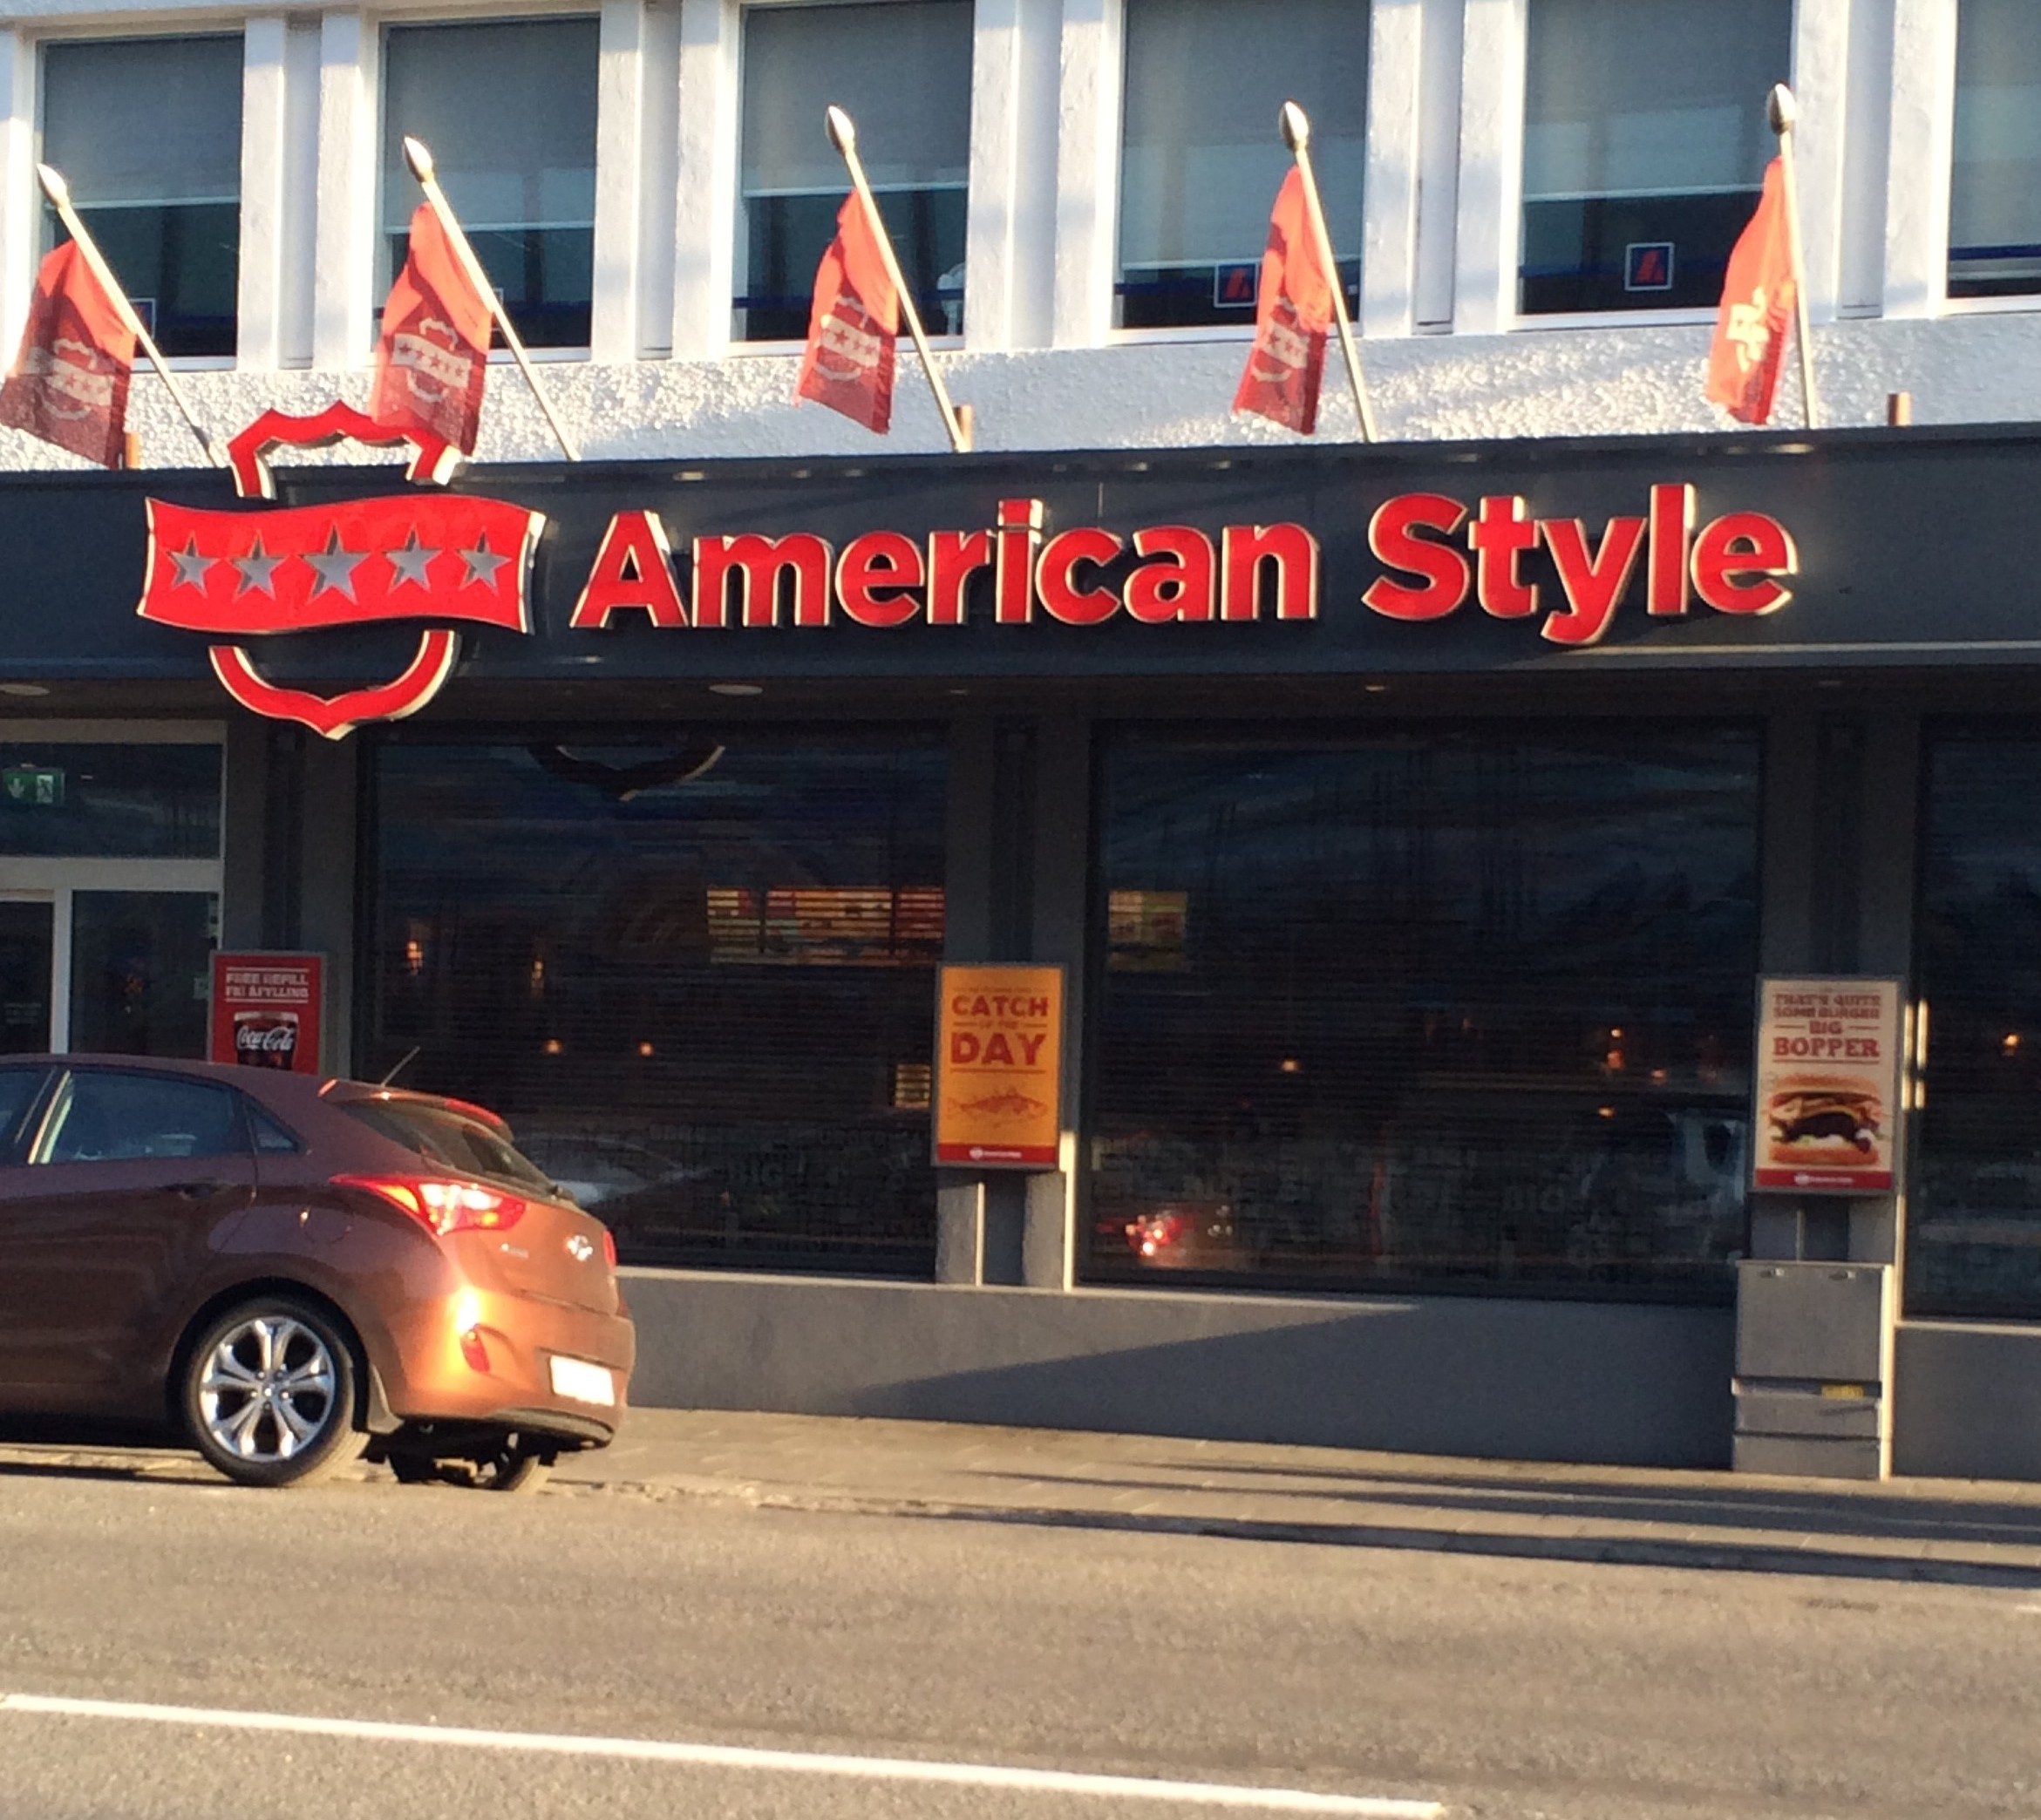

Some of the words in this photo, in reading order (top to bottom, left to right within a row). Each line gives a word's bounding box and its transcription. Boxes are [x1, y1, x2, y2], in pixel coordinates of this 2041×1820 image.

[567, 498, 1322, 628] American
[1361, 483, 1798, 646] Style
[951, 995, 1049, 1017] CATCH
[1818, 1007, 1880, 1020] BURGER
[1809, 1020, 1843, 1035] BIG
[950, 1032, 1046, 1066] DAY
[1772, 1036, 1881, 1058] BOPPER
